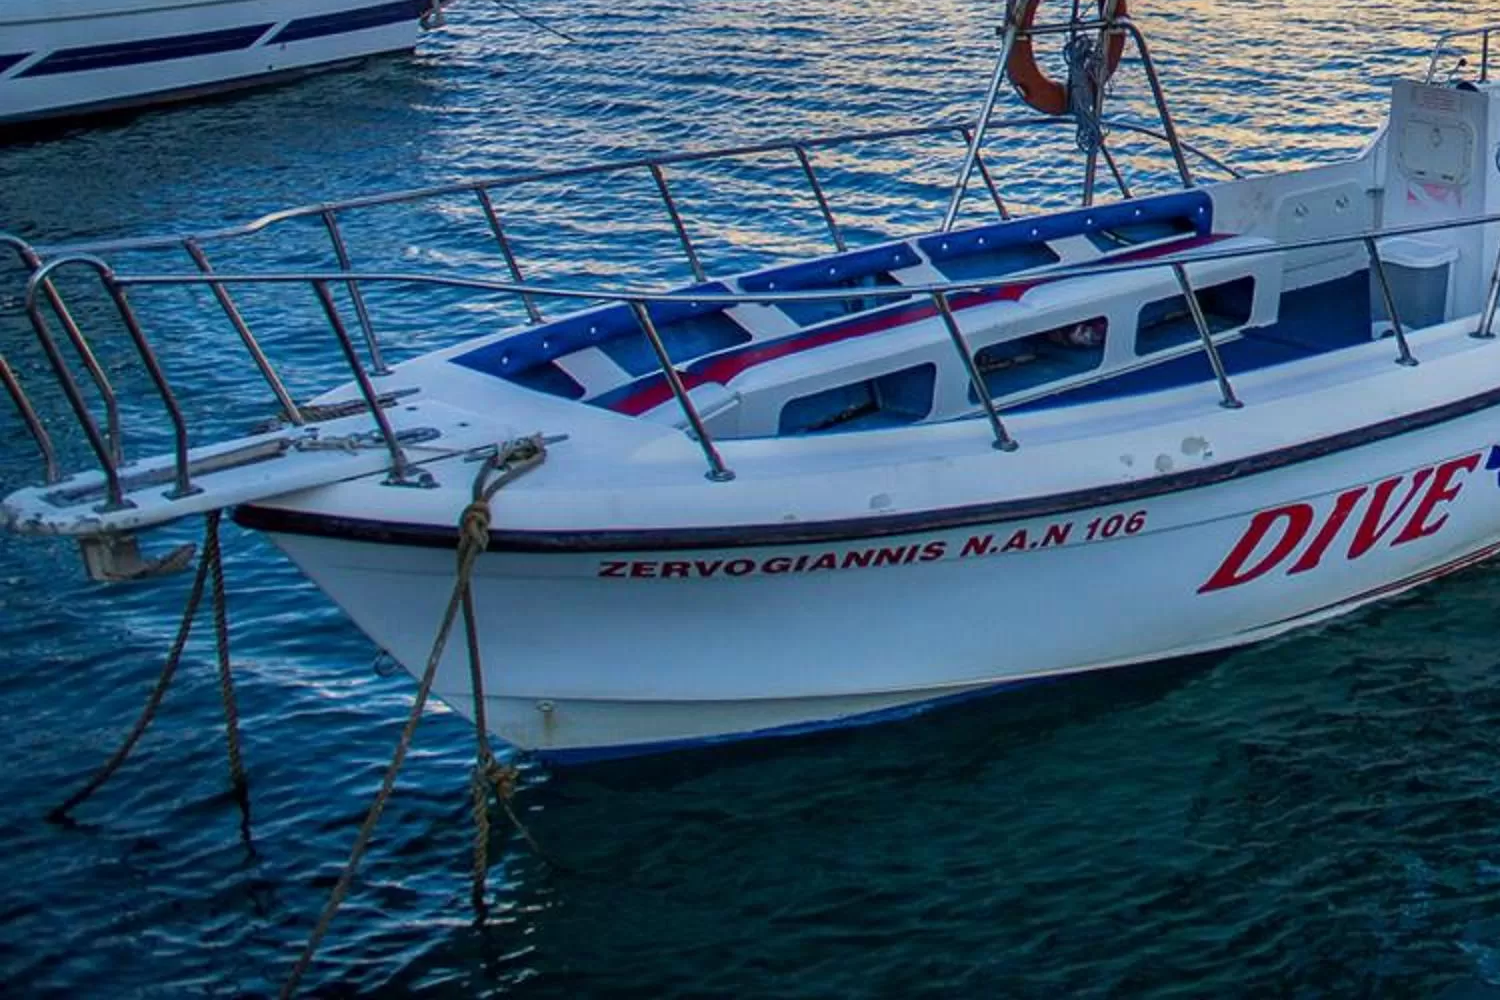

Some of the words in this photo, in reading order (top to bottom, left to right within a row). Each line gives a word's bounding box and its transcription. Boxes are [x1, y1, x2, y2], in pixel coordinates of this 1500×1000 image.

[599, 541, 947, 579] ZERVOGIANNIS
[960, 522, 1073, 557] N.A.N
[1084, 510, 1148, 541] 106
[1196, 453, 1484, 594] DIVE
